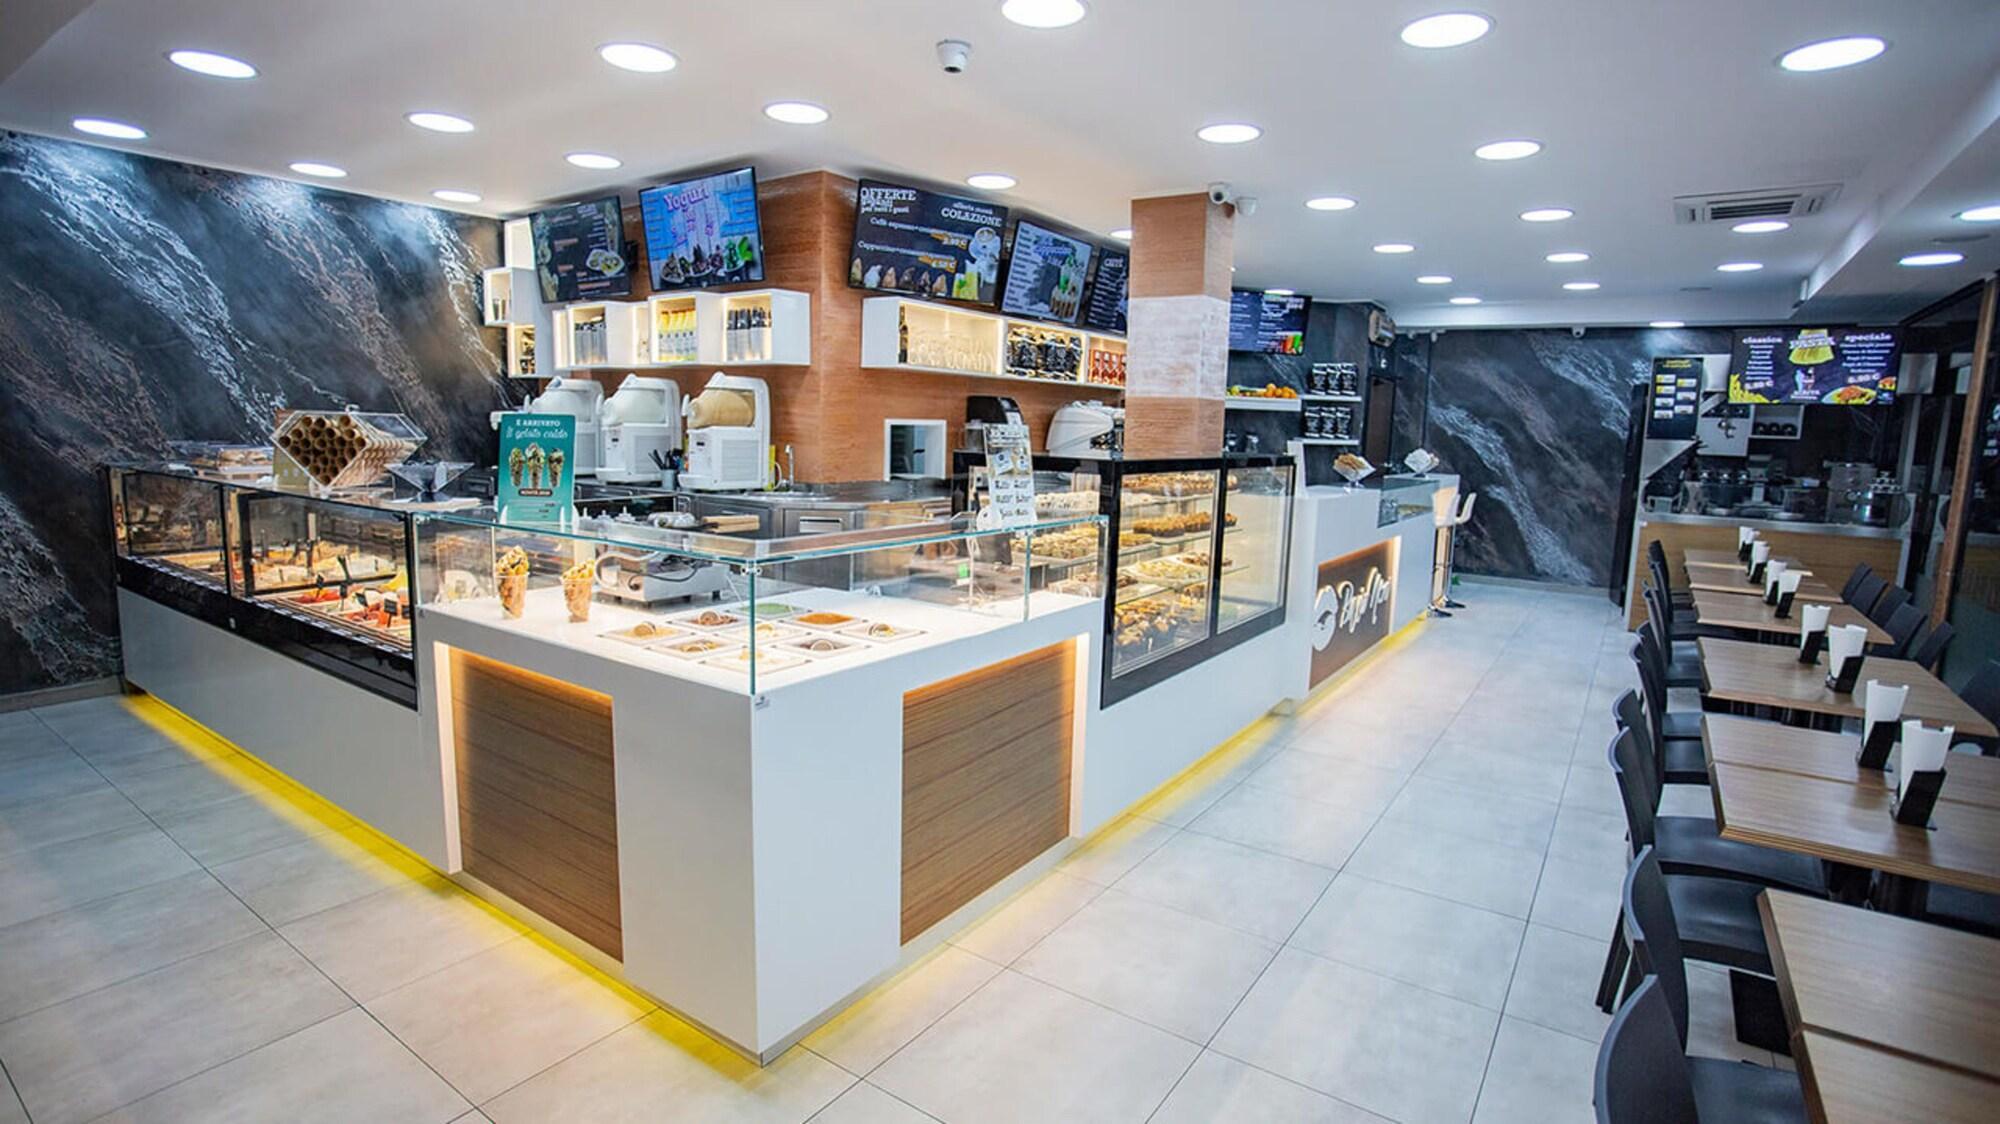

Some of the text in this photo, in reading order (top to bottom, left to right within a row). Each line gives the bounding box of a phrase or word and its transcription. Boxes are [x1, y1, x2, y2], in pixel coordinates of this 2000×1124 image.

[664, 184, 709, 212] Yogurt
[860, 187, 917, 201] OFFERTE
[941, 207, 1003, 227] COLAZIONE
